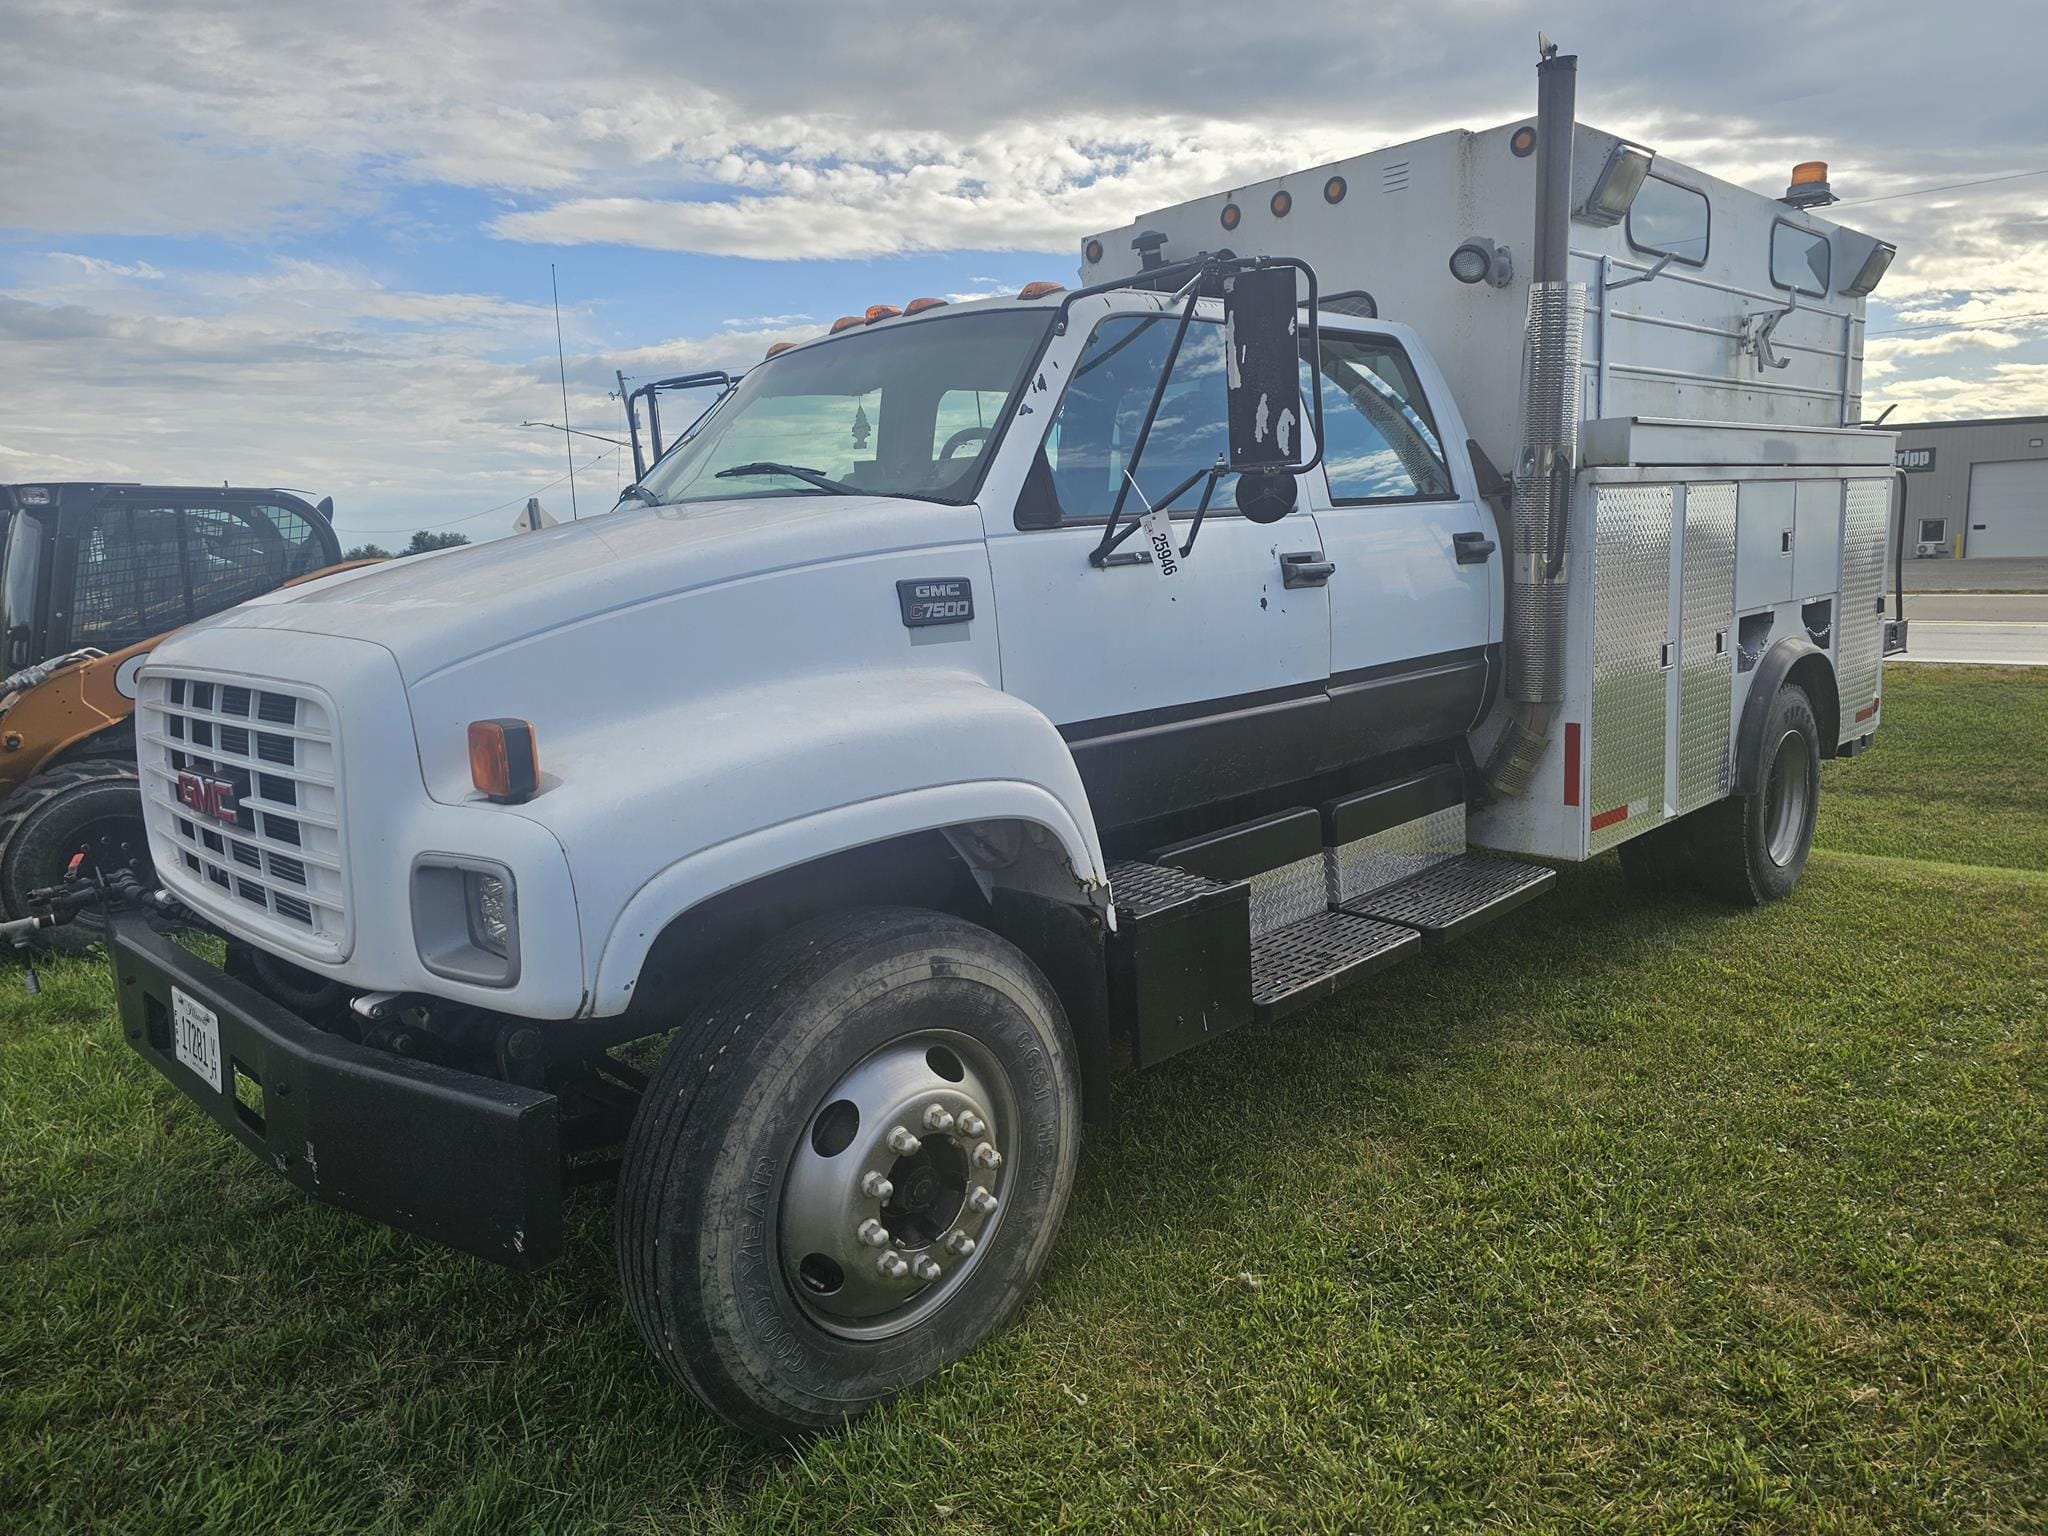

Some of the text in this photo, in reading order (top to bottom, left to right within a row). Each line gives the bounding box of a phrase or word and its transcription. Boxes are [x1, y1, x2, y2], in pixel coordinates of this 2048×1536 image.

[1895, 450, 1929, 467] ripp
[1152, 533, 1178, 576] 25946
[915, 583, 960, 598] GMC
[910, 601, 969, 620] C7500
[178, 771, 236, 823] GMC
[182, 1016, 208, 1068] 17281
